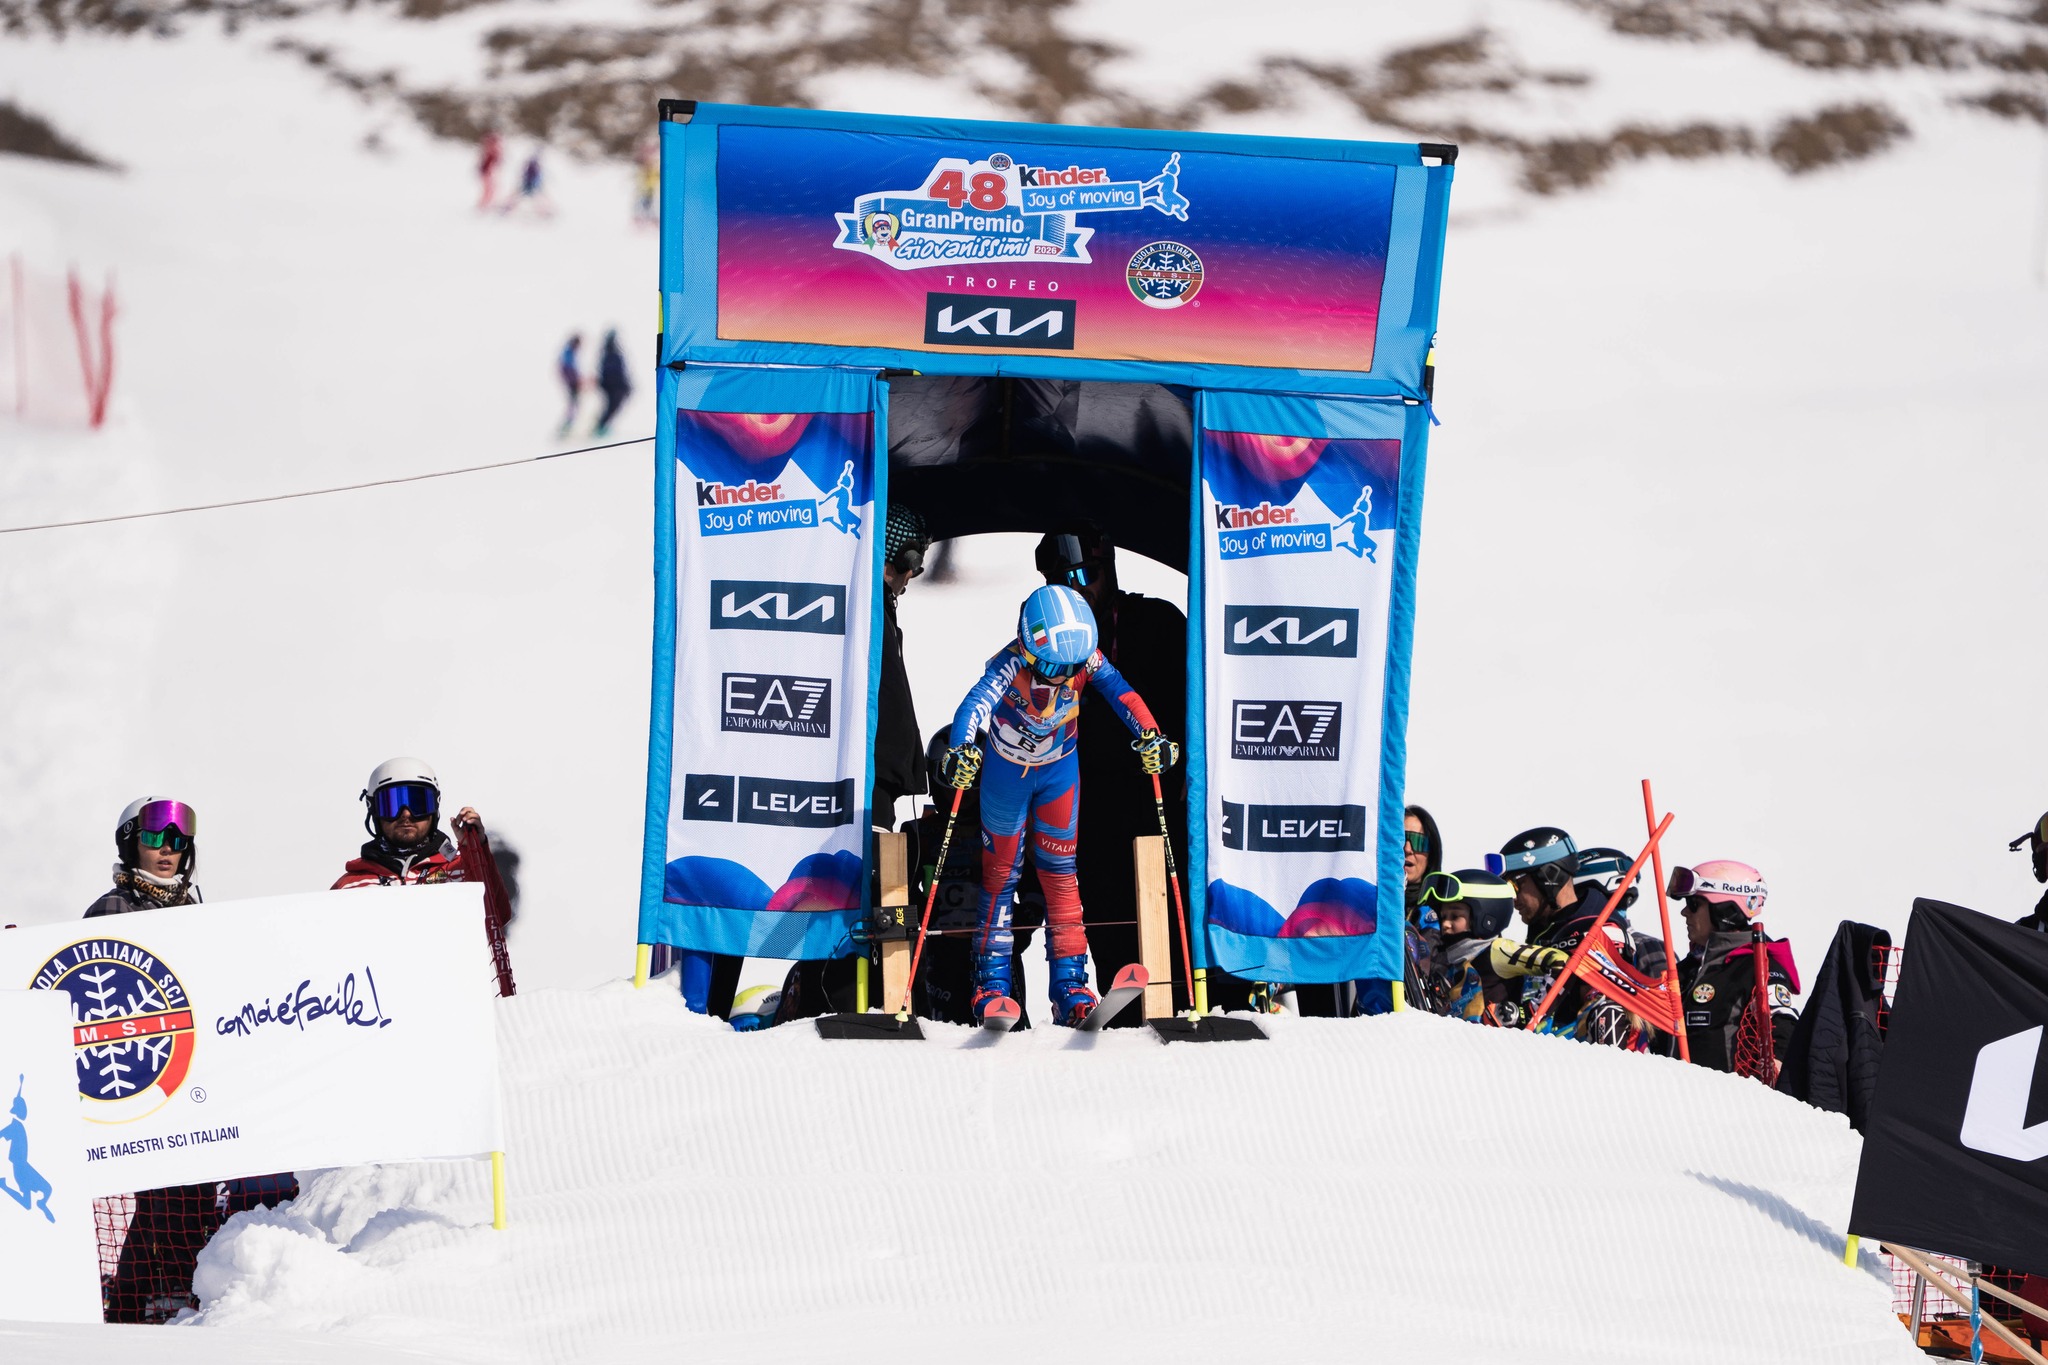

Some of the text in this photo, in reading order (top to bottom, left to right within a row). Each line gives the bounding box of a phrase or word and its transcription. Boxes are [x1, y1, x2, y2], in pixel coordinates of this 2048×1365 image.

[929, 169, 1008, 211] 48
[1027, 188, 1135, 209] Joy of moving
[901, 208, 1025, 234] GranPremio
[895, 236, 1031, 261] Giovanissimi
[1035, 245, 1057, 255] 2026
[1131, 243, 1201, 271] SCUOLA ITALIANA SCI
[946, 275, 1059, 292] TROFEO
[937, 305, 1064, 338] KIA
[705, 505, 812, 531] Joy of moving
[1220, 530, 1326, 556] Joy of moving
[721, 591, 835, 623] KIA
[1233, 616, 1348, 647] KIA
[725, 676, 828, 720] EA7
[1007, 690, 1030, 707] EA7
[725, 716, 827, 735] EMPORIO ARMANI
[1235, 704, 1338, 744] EA7
[1018, 736, 1037, 754] B
[1235, 743, 1336, 757] EMPORIO ARMANI
[752, 791, 843, 814] LEVEL
[1262, 819, 1351, 838] LEVEL
[1722, 883, 1743, 893] Red
[33, 941, 186, 1005] OLA ITALIANA SCI
[110, 1137, 164, 1158] MAESTRI
[167, 1133, 188, 1149] SCI
[190, 1126, 240, 1145] ITALIANI
